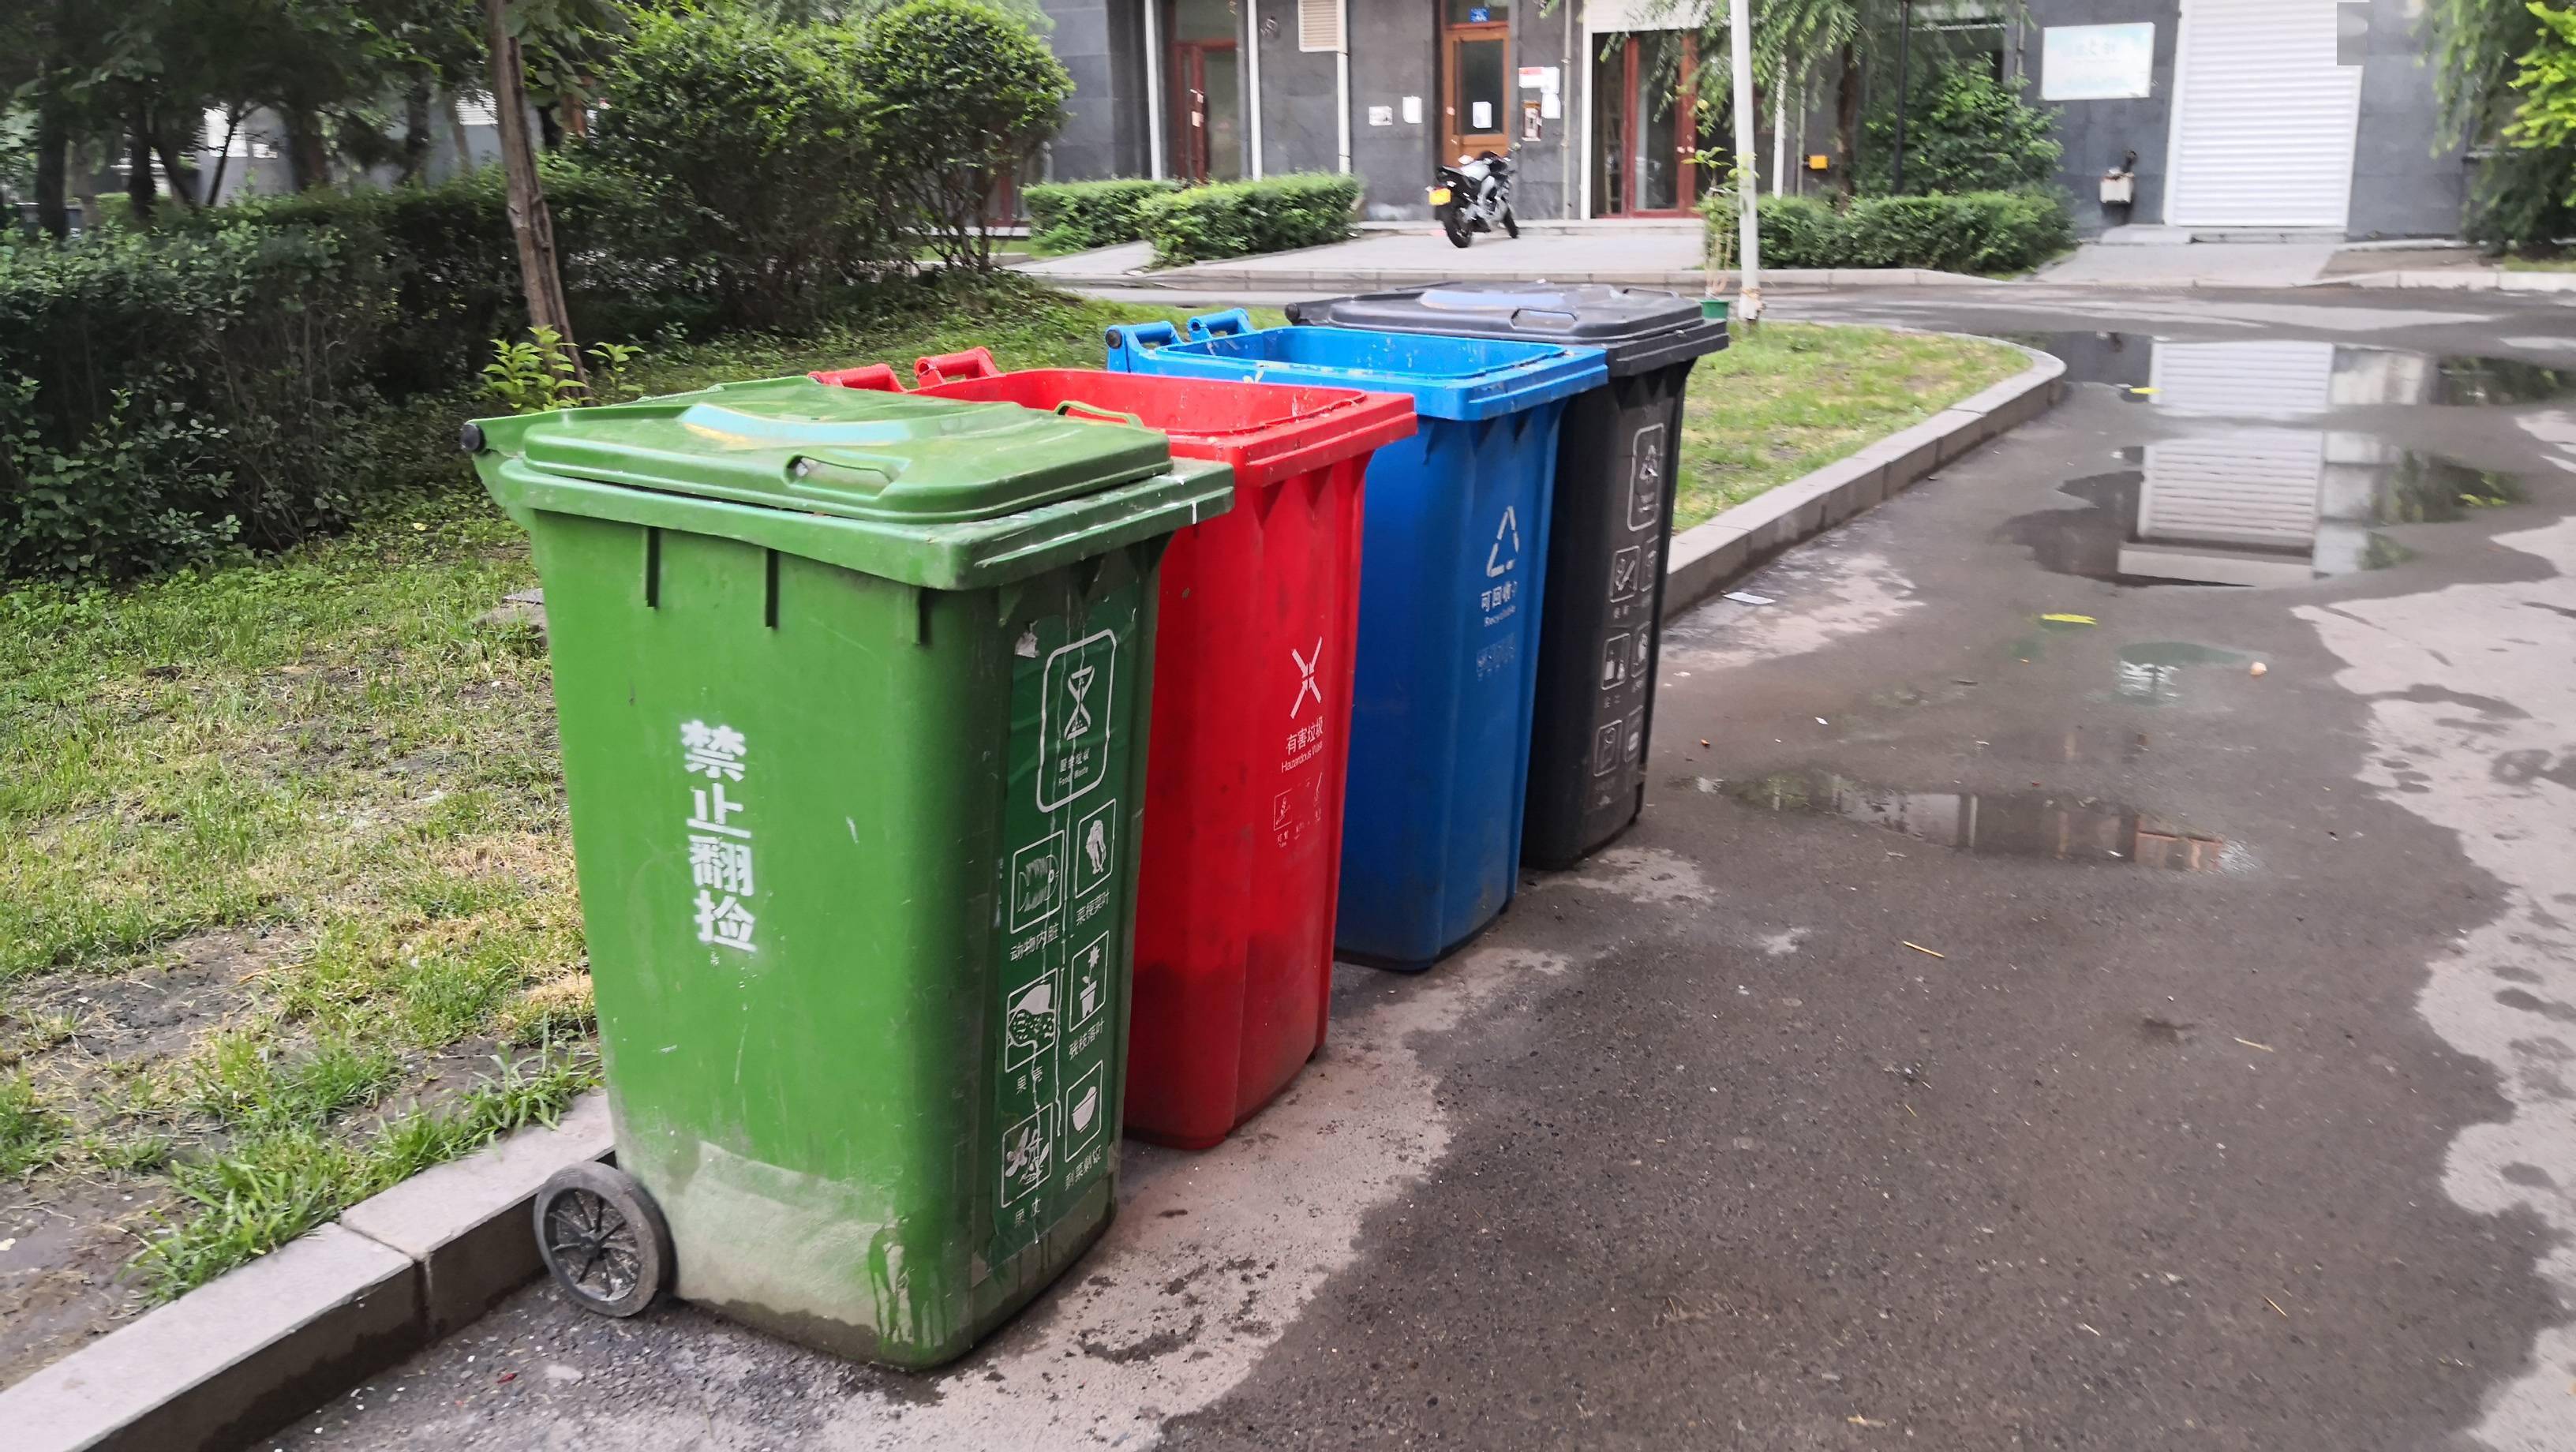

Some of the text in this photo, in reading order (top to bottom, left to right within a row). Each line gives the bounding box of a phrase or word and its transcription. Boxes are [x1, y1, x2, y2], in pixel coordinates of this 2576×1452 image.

[1286, 716, 1323, 755] 有害垃圾
[680, 720, 757, 952] 禁止翻捡
